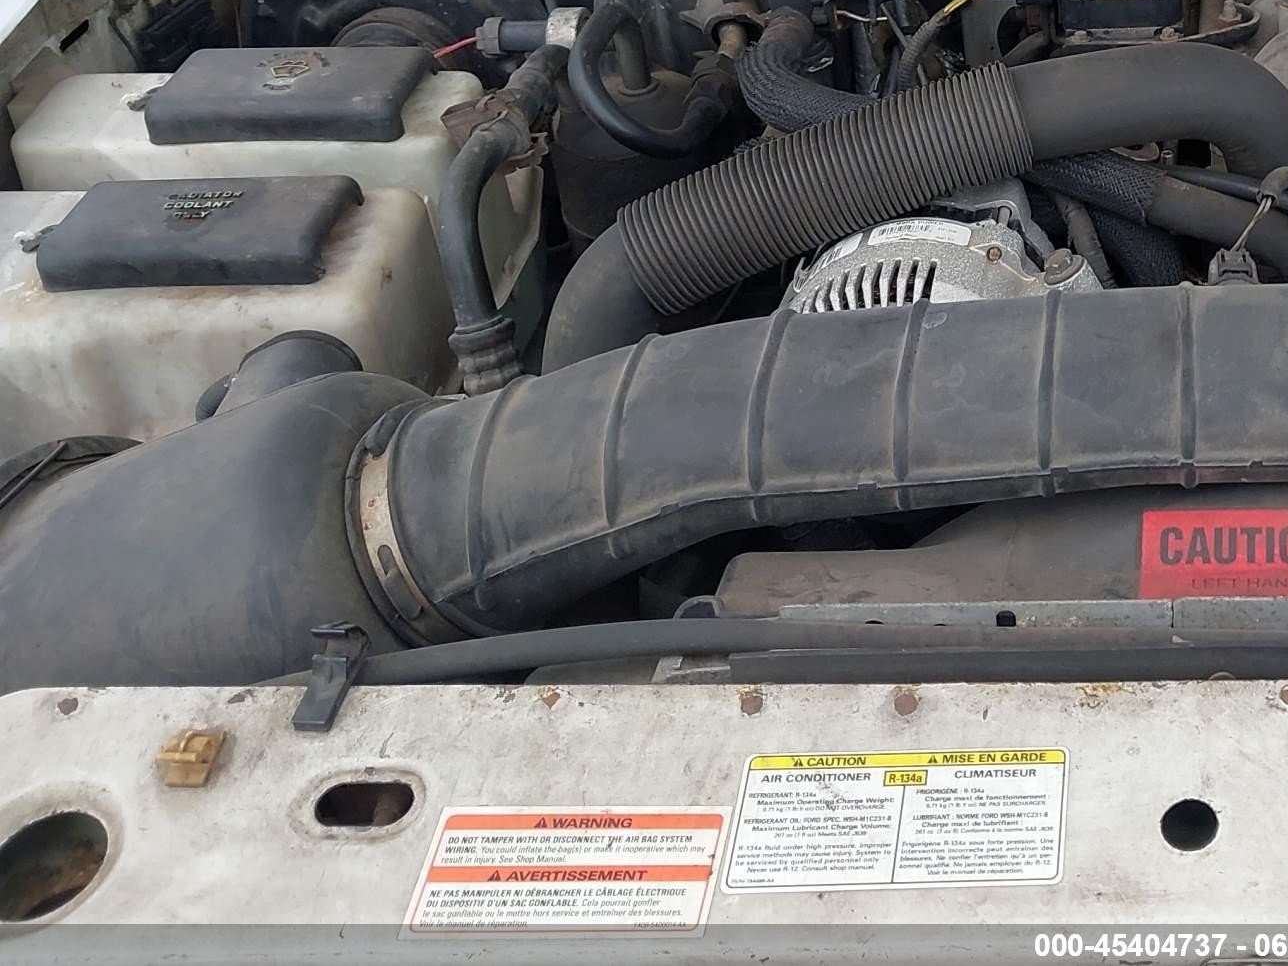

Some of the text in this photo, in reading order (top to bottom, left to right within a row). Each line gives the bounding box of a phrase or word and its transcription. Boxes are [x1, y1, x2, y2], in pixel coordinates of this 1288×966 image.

[168, 190, 244, 200] RADIATOR
[164, 200, 234, 210] COOLANT
[1191, 577, 1243, 589] LEFT
[807, 757, 866, 766] CAUTION
[942, 753, 1046, 763] MISE EN GARDE
[761, 773, 871, 783] AIR CONDITIONER
[888, 774, 923, 783] R-134a
[954, 769, 1037, 778] CLIMATISEUR
[552, 818, 633, 828] WARNING
[461, 836, 479, 844] NOT
[480, 836, 514, 844] TAMPER
[659, 835, 693, 843] SYSTEM
[623, 846, 664, 854] inoperative
[515, 856, 534, 865] Shop
[536, 855, 567, 863] Manual.
[506, 870, 648, 882] AVERTISSEMENT
[461, 889, 511, 897] MANIPULER
[513, 889, 523, 897] NI
[525, 887, 581, 897] DÉBRANCHER
[583, 889, 594, 897] LE
[636, 886, 687, 896] ÉLECTRIQUE
[487, 899, 508, 907] D'UN
[509, 899, 527, 907] SAC
[600, 899, 631, 908] pourrait
[633, 899, 661, 908] gonfler
[447, 909, 483, 919] gonflable
[496, 909, 504, 917] le
[533, 909, 550, 917] hors
[552, 909, 579, 917] service
[581, 909, 589, 917] et
[419, 920, 434, 928] Voir
[436, 920, 444, 928] le
[445, 920, 474, 928] manuel
[475, 920, 485, 928] de
